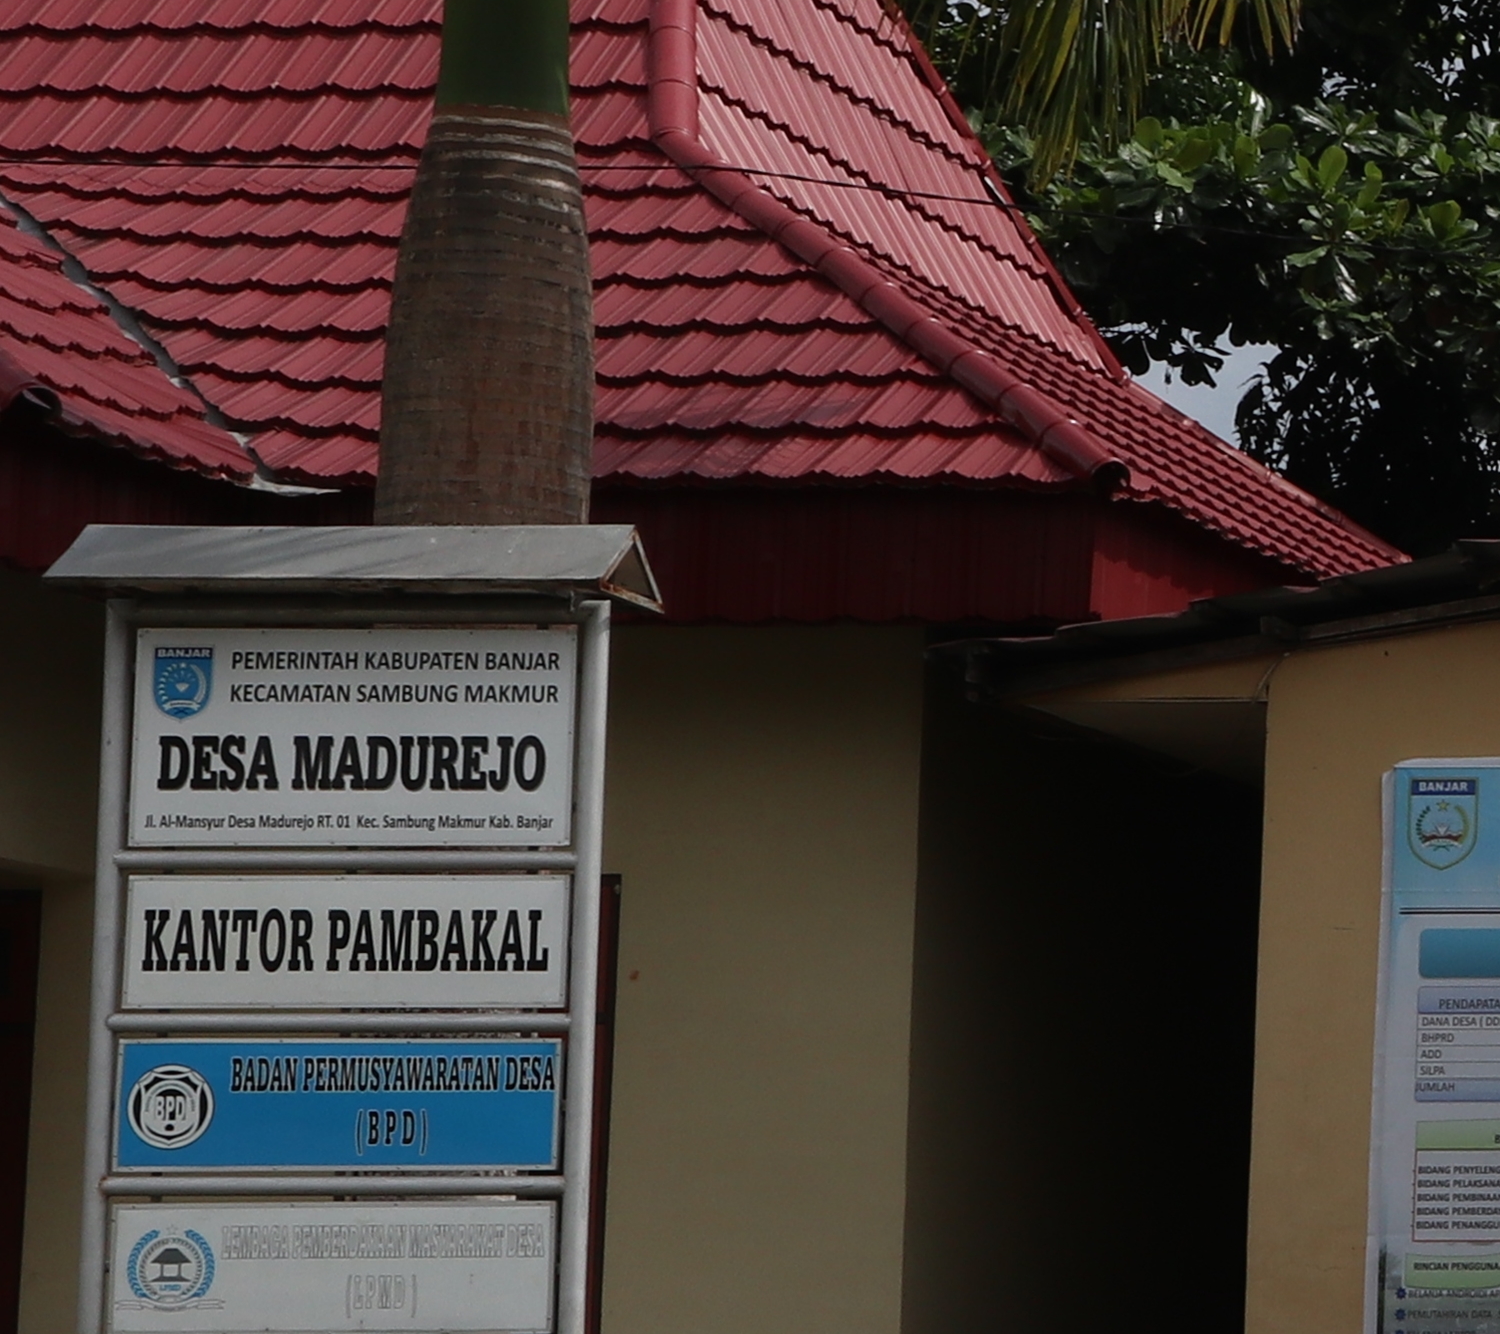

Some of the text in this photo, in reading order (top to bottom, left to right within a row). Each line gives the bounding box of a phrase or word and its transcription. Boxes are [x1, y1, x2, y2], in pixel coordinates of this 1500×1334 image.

[158, 649, 210, 657] BANJAR
[232, 652, 560, 671] PEMERINTAH KABUPATEN BANJAR
[230, 684, 558, 703] KECAMATAN SAMBUNG MAKMUR
[157, 735, 546, 791] DESA MADUREJO
[1418, 781, 1468, 792] BANJAR
[159, 815, 225, 832] Al-Mansyur
[228, 815, 256, 828] Desa
[259, 815, 314, 832] Madurejo
[318, 815, 333, 828] RT.
[336, 815, 350, 828] 01
[356, 815, 379, 829] Kec.
[383, 815, 435, 832] Sambung
[438, 815, 486, 828] Makmur
[489, 815, 513, 828] Kab.
[517, 815, 553, 832] Banjar
[141, 908, 549, 972] KANTOR PAMBAKAL
[1421, 1016, 1450, 1028] DANA
[1452, 1016, 1477, 1028] DESA
[1421, 1033, 1454, 1043] BHPRD
[1420, 1049, 1442, 1060] ADD
[230, 1057, 555, 1092] BADAN PERMUSYAWARATAN DESA
[1420, 1065, 1445, 1076] SILPA
[153, 1095, 187, 1121] BPD
[1418, 1165, 1450, 1175] BIDANG
[1417, 1179, 1450, 1189] BIDANG
[221, 1224, 545, 1259] LEMBAGA PEMBERDAYAAN MASYARAKAT DESA
[1413, 1262, 1449, 1272] RINCIAN
